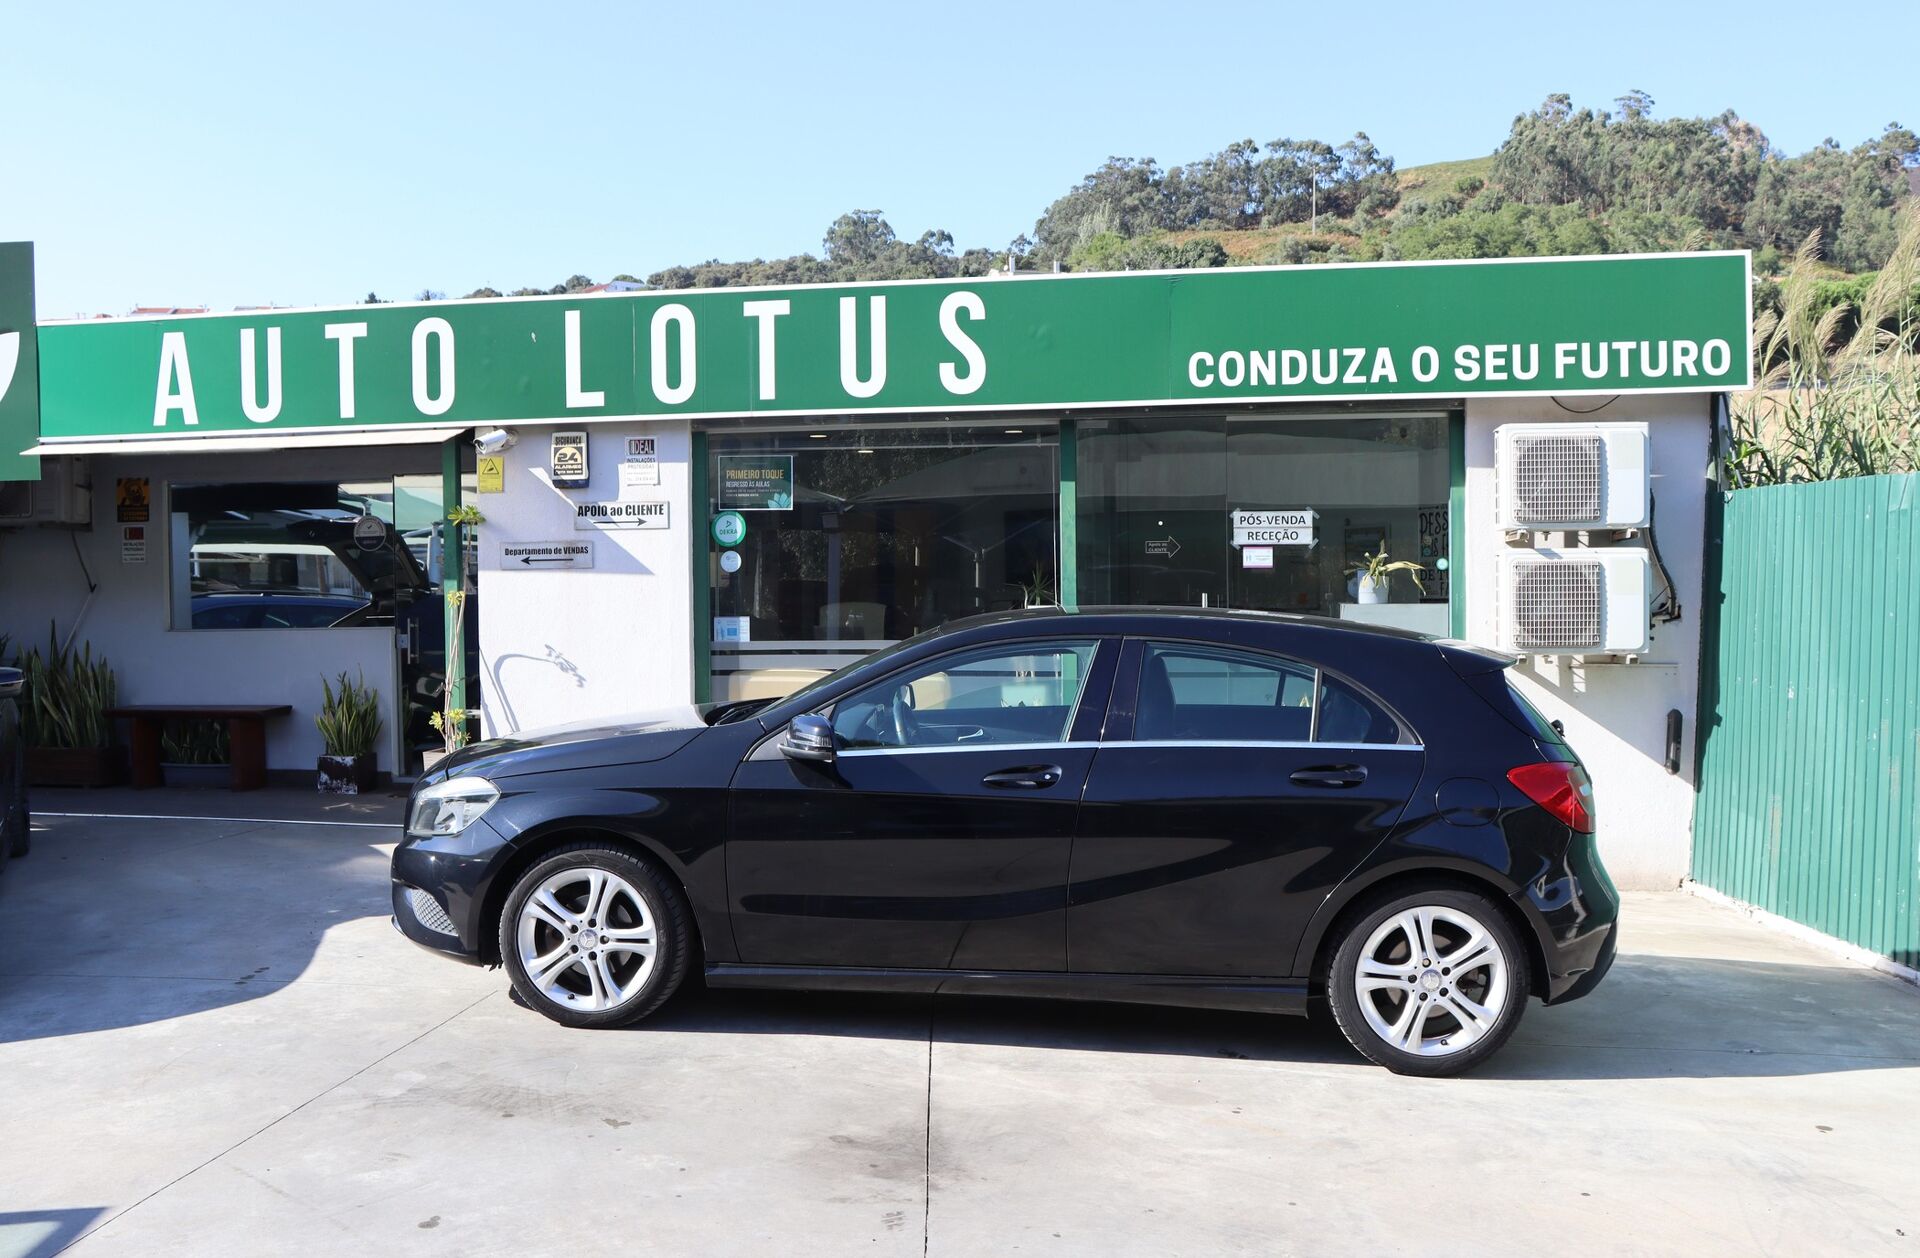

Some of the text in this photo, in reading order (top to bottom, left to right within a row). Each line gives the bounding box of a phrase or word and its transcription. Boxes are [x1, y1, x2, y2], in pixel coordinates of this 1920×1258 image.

[153, 290, 987, 427] AUTO LOTUS
[1188, 338, 1732, 388] CONDUZA O SEU FUTURO
[630, 440, 655, 455] IDEAL
[557, 452, 579, 463] 24
[726, 469, 785, 480] PRIMEIRO TOQUE
[577, 504, 665, 517] APOIO ao CLIENTE
[1239, 513, 1306, 526] PÓS-VENDA
[719, 528, 738, 536] DEKRA
[1247, 528, 1299, 543] RECEÇÃO
[504, 546, 589, 557] Departamento de VENDAS
